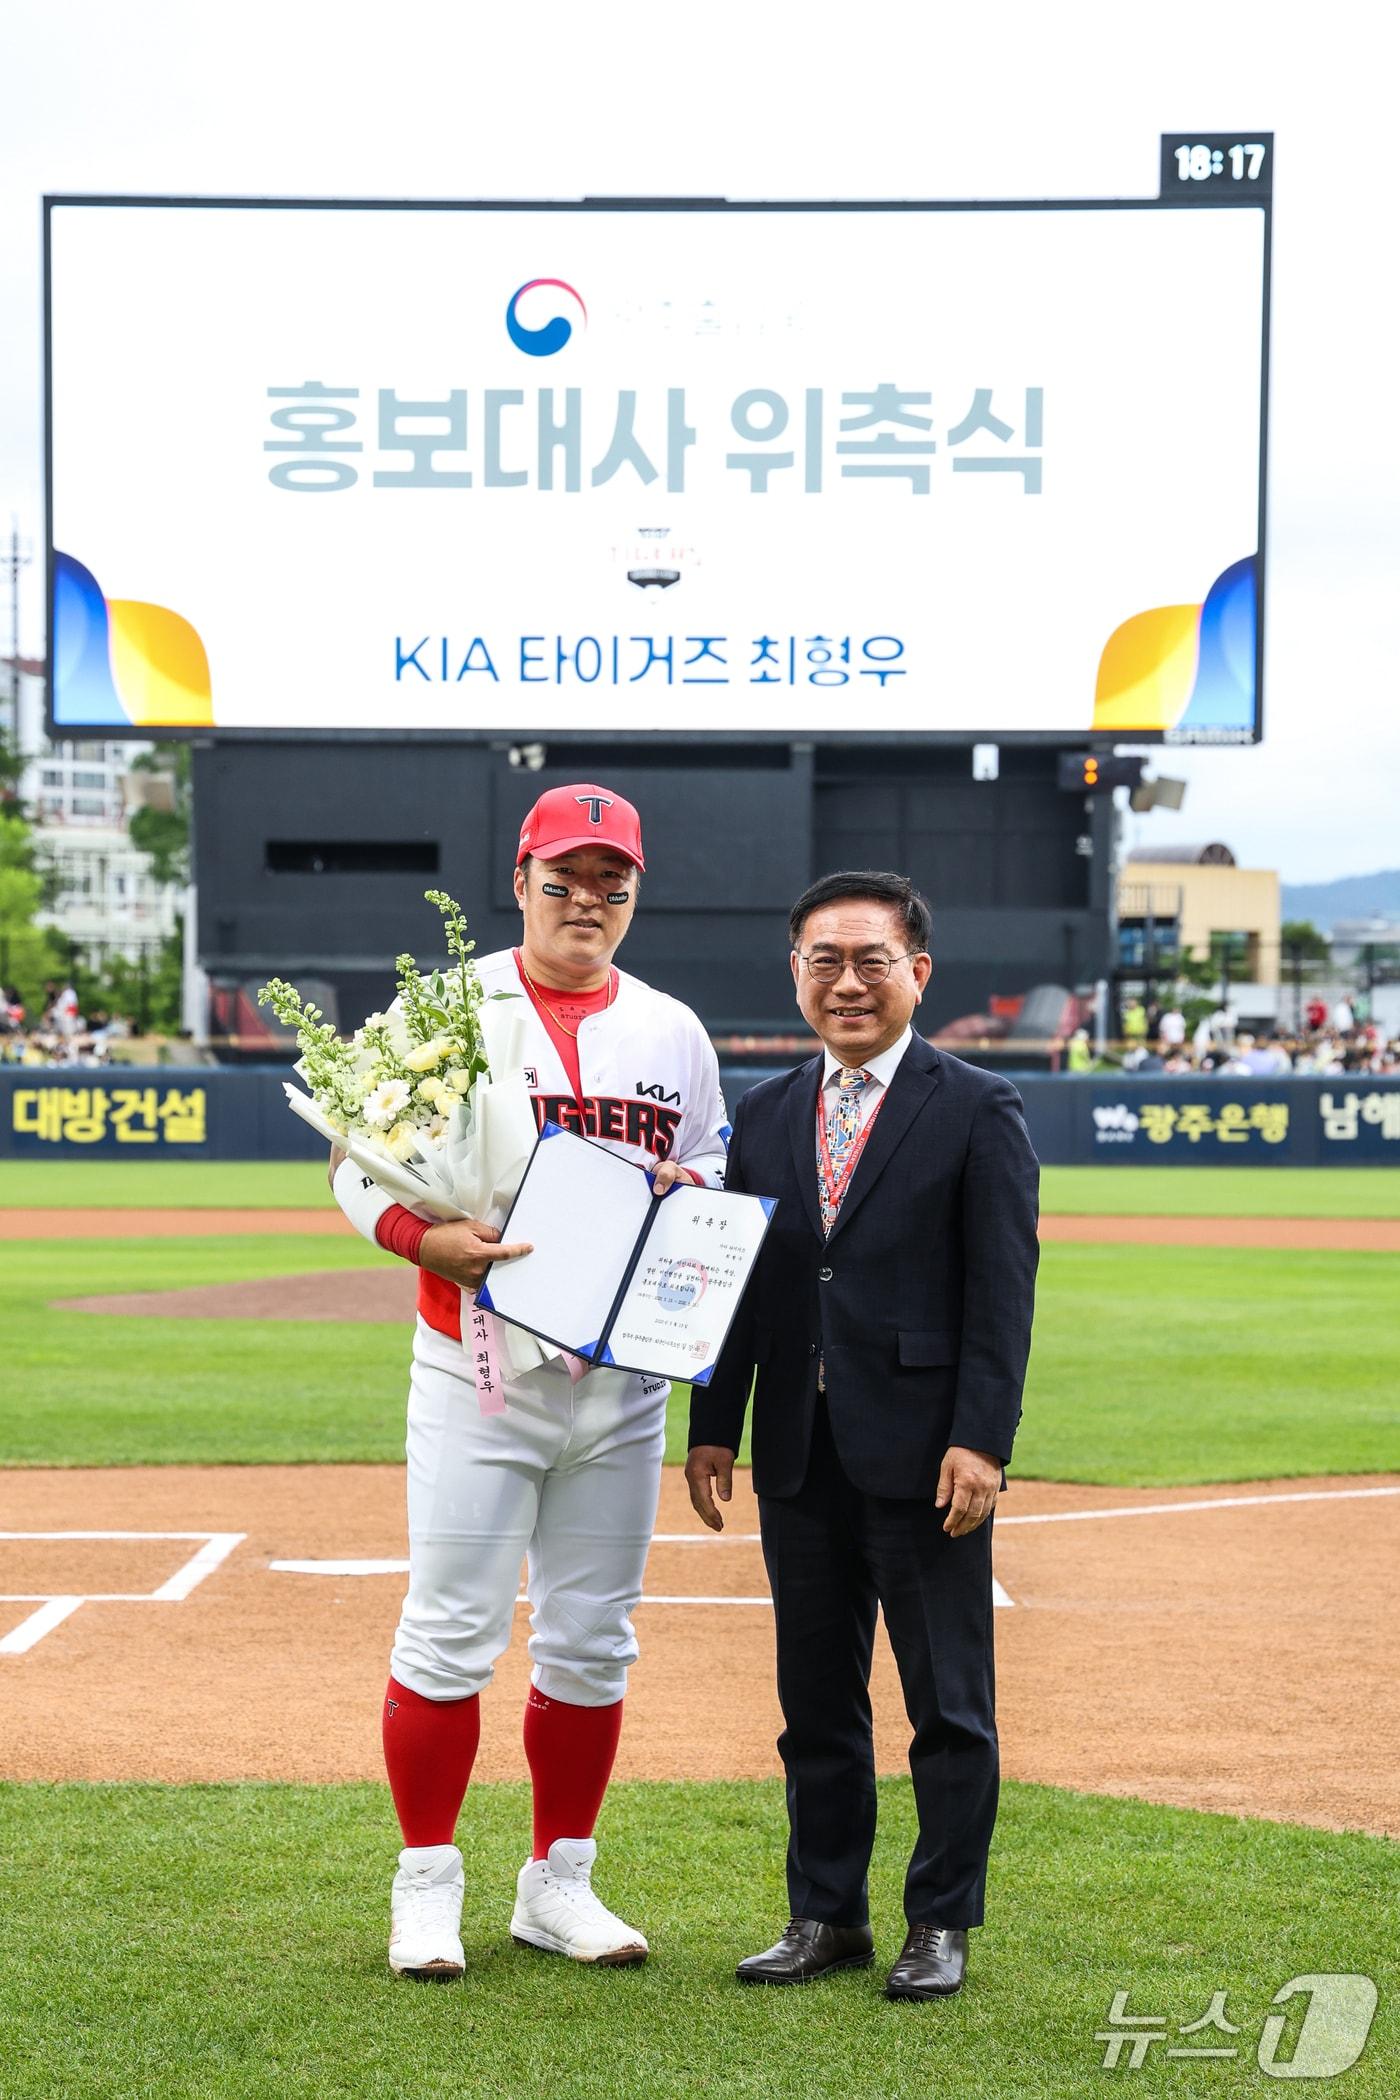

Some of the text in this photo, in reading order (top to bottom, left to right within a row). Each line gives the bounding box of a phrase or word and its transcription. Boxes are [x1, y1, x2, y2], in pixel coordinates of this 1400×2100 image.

[1174, 143, 1265, 181] 18:17
[263, 381, 1044, 494] 홍보대사 위촉식
[394, 633, 907, 687] KIA 타이거즈 최형우
[574, 794, 614, 825] T
[12, 1087, 206, 1144] 대방건설
[1139, 1103, 1290, 1144] 광주은행
[472, 1308, 495, 1394] 대사 최형우
